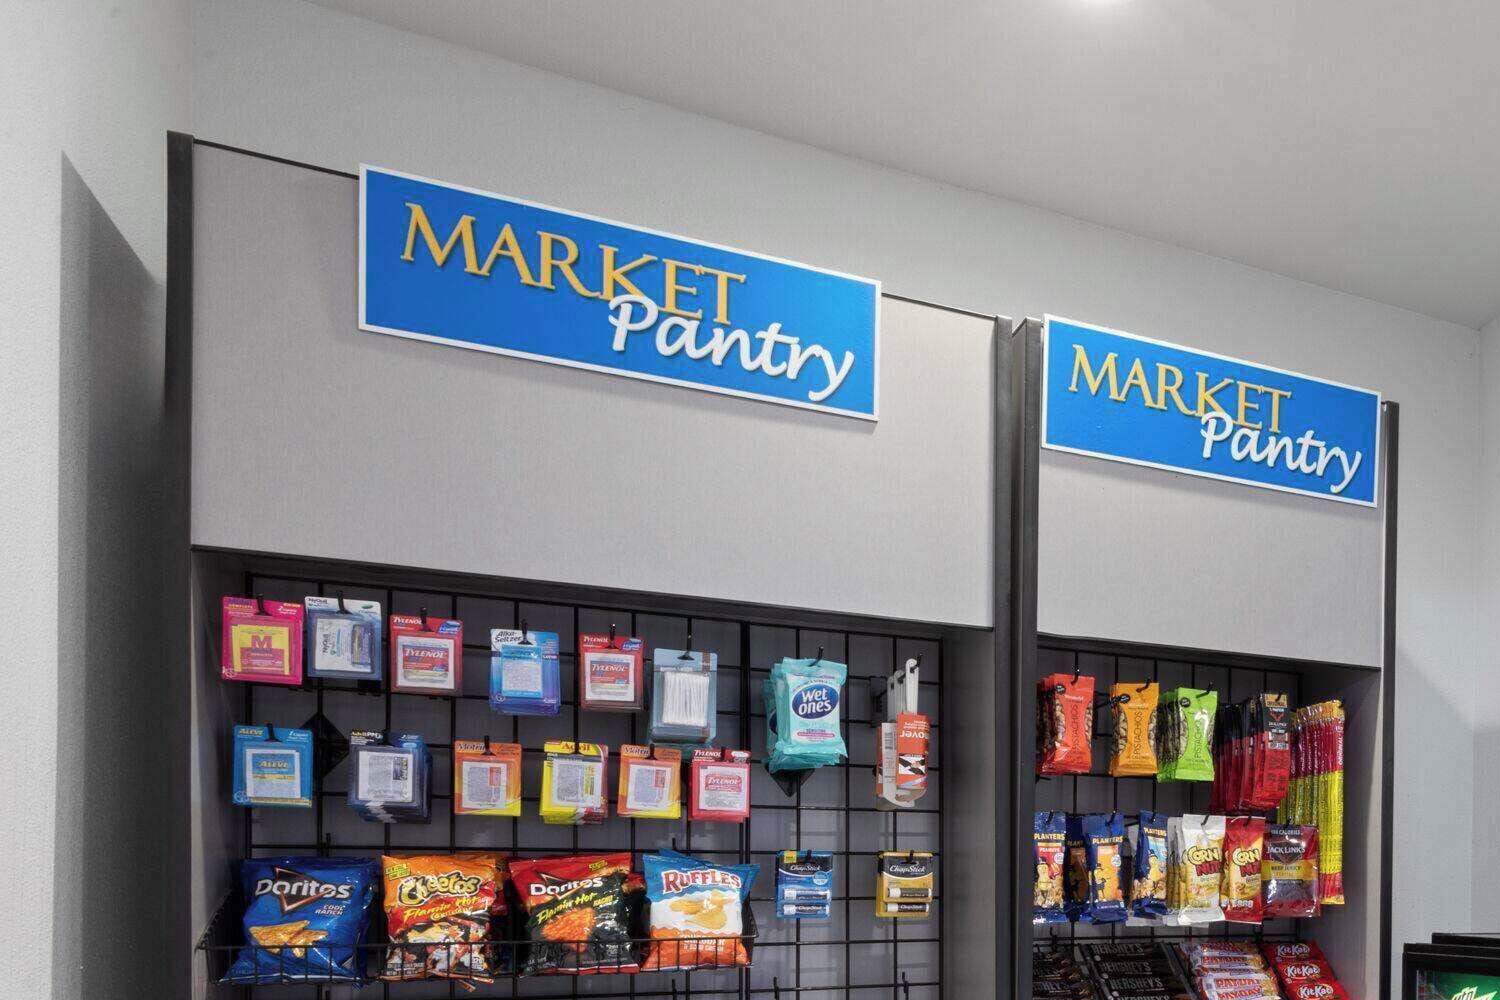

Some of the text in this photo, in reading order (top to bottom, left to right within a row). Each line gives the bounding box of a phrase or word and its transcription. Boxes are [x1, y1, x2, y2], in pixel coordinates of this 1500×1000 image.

[400, 202, 747, 325] MARKET
[608, 294, 855, 402] Pantry
[1068, 344, 1292, 433] MARKET
[1200, 411, 1363, 494] Pantry
[404, 649, 446, 659] TYLENOL
[801, 687, 828, 703] wet
[798, 700, 832, 715] ones
[1034, 833, 1066, 841] PLANTERS
[1093, 835, 1124, 845] PLANTERS
[1187, 846, 1219, 865] CORN
[1232, 848, 1261, 865] CORN
[254, 878, 353, 900] Doritos
[398, 871, 482, 906] Cheetos
[530, 877, 604, 896] Doritos
[662, 869, 742, 894] RUFFLES
